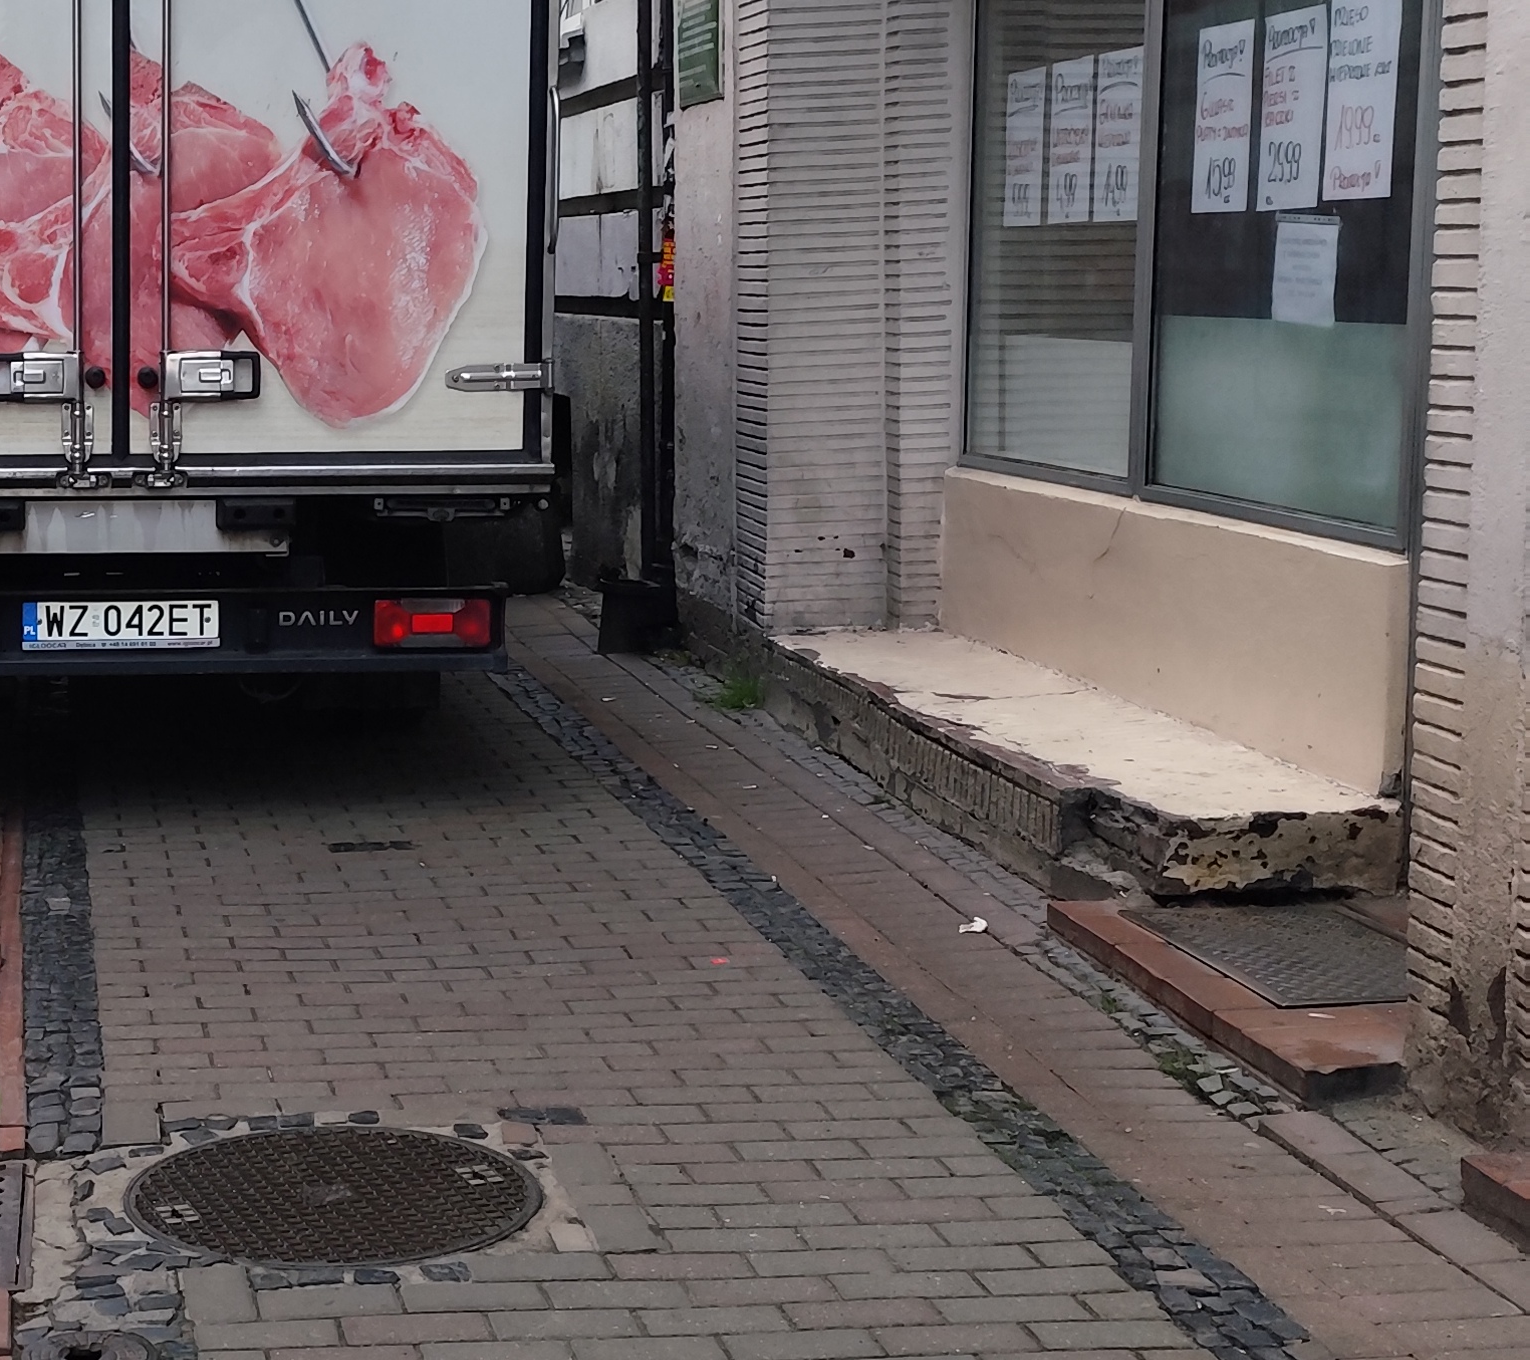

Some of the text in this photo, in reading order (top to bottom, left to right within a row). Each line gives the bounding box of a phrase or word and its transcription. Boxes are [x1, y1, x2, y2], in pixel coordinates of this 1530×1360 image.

[45, 603, 212, 637] WZ 042ET
[278, 610, 359, 626] DAILY
[23, 625, 36, 636] PL
